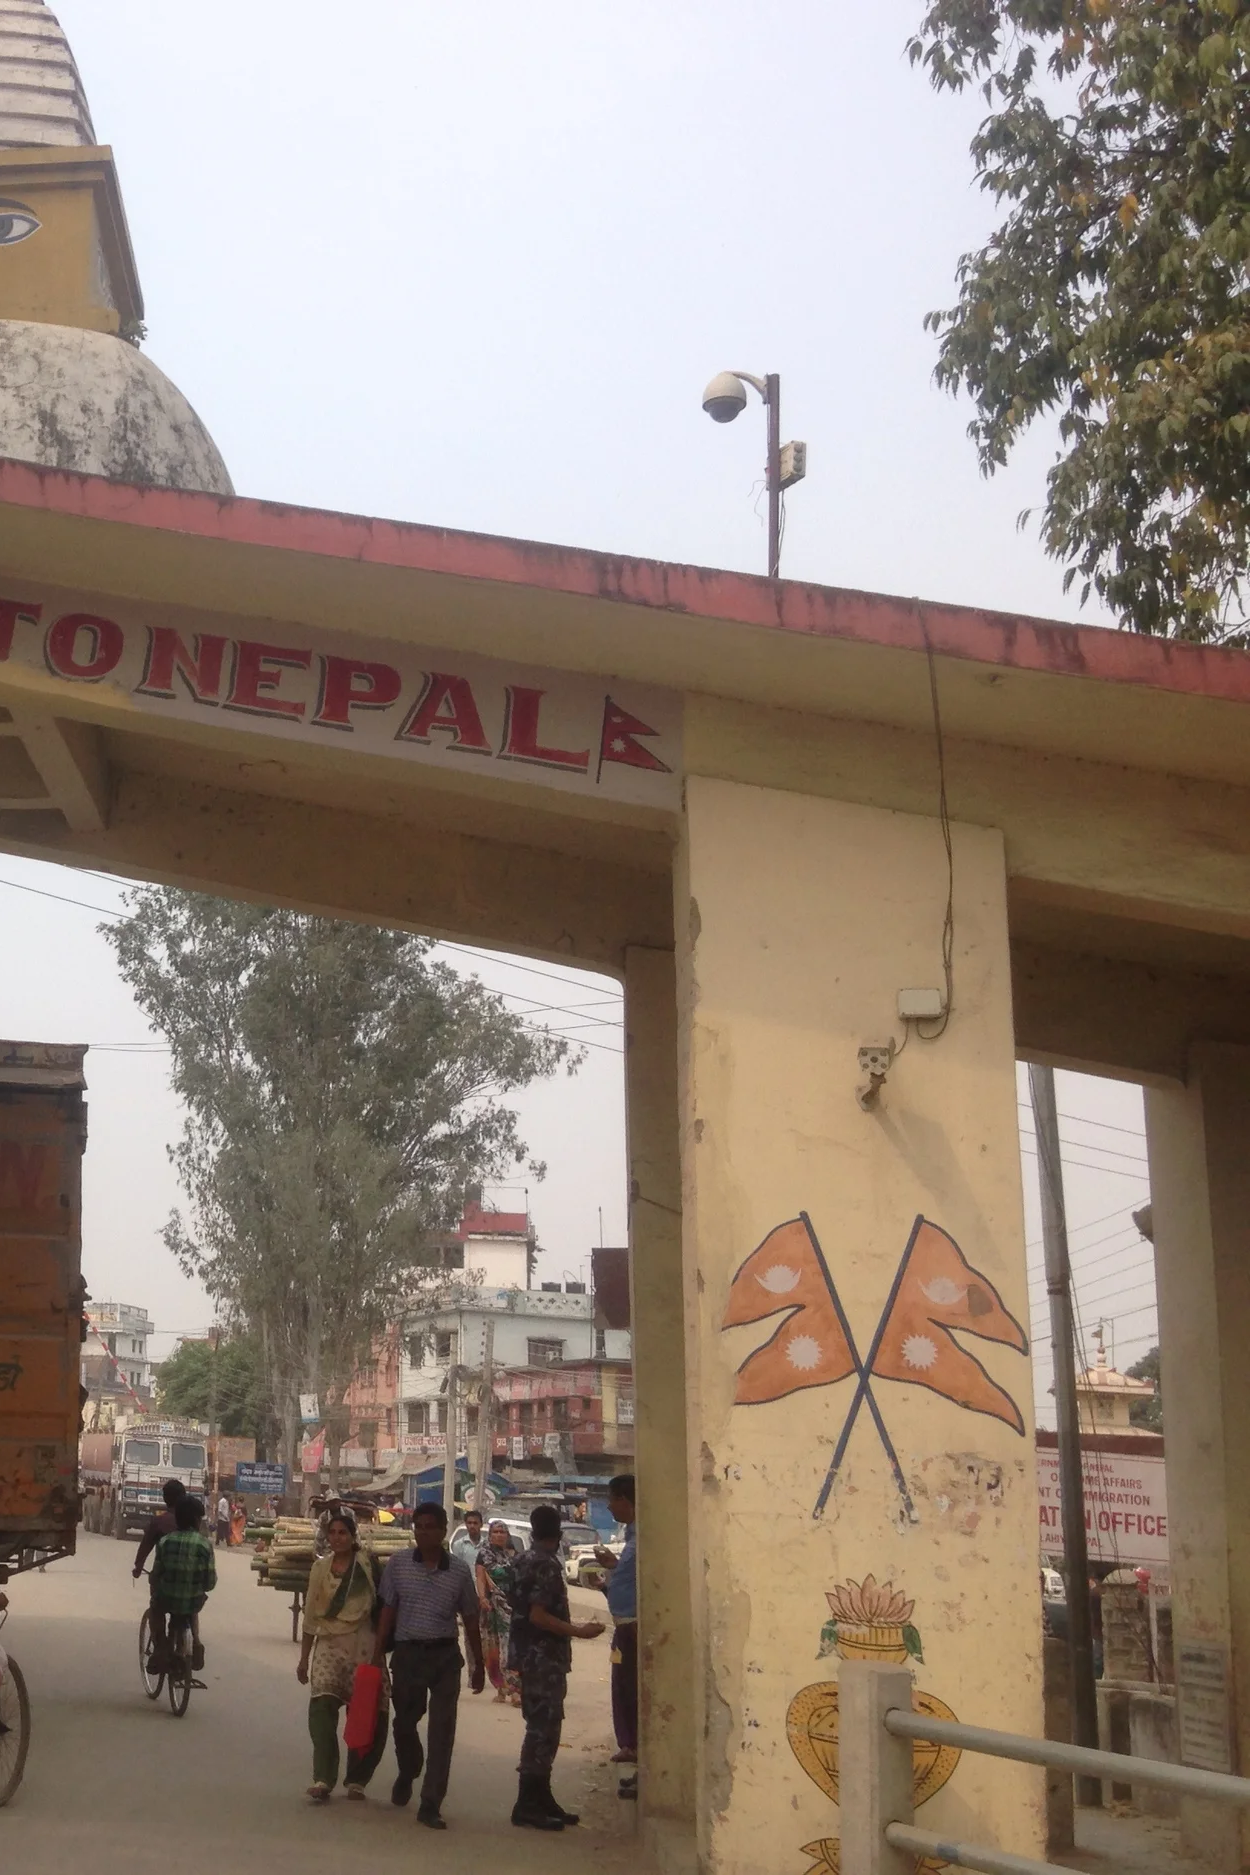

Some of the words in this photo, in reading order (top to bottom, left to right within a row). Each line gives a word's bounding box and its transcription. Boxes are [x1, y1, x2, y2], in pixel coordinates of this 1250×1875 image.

[133, 625, 590, 773] NEPAL
[1103, 1477, 1142, 1490] AFFAIRS
[1098, 1510, 1167, 1537] OFFICE
